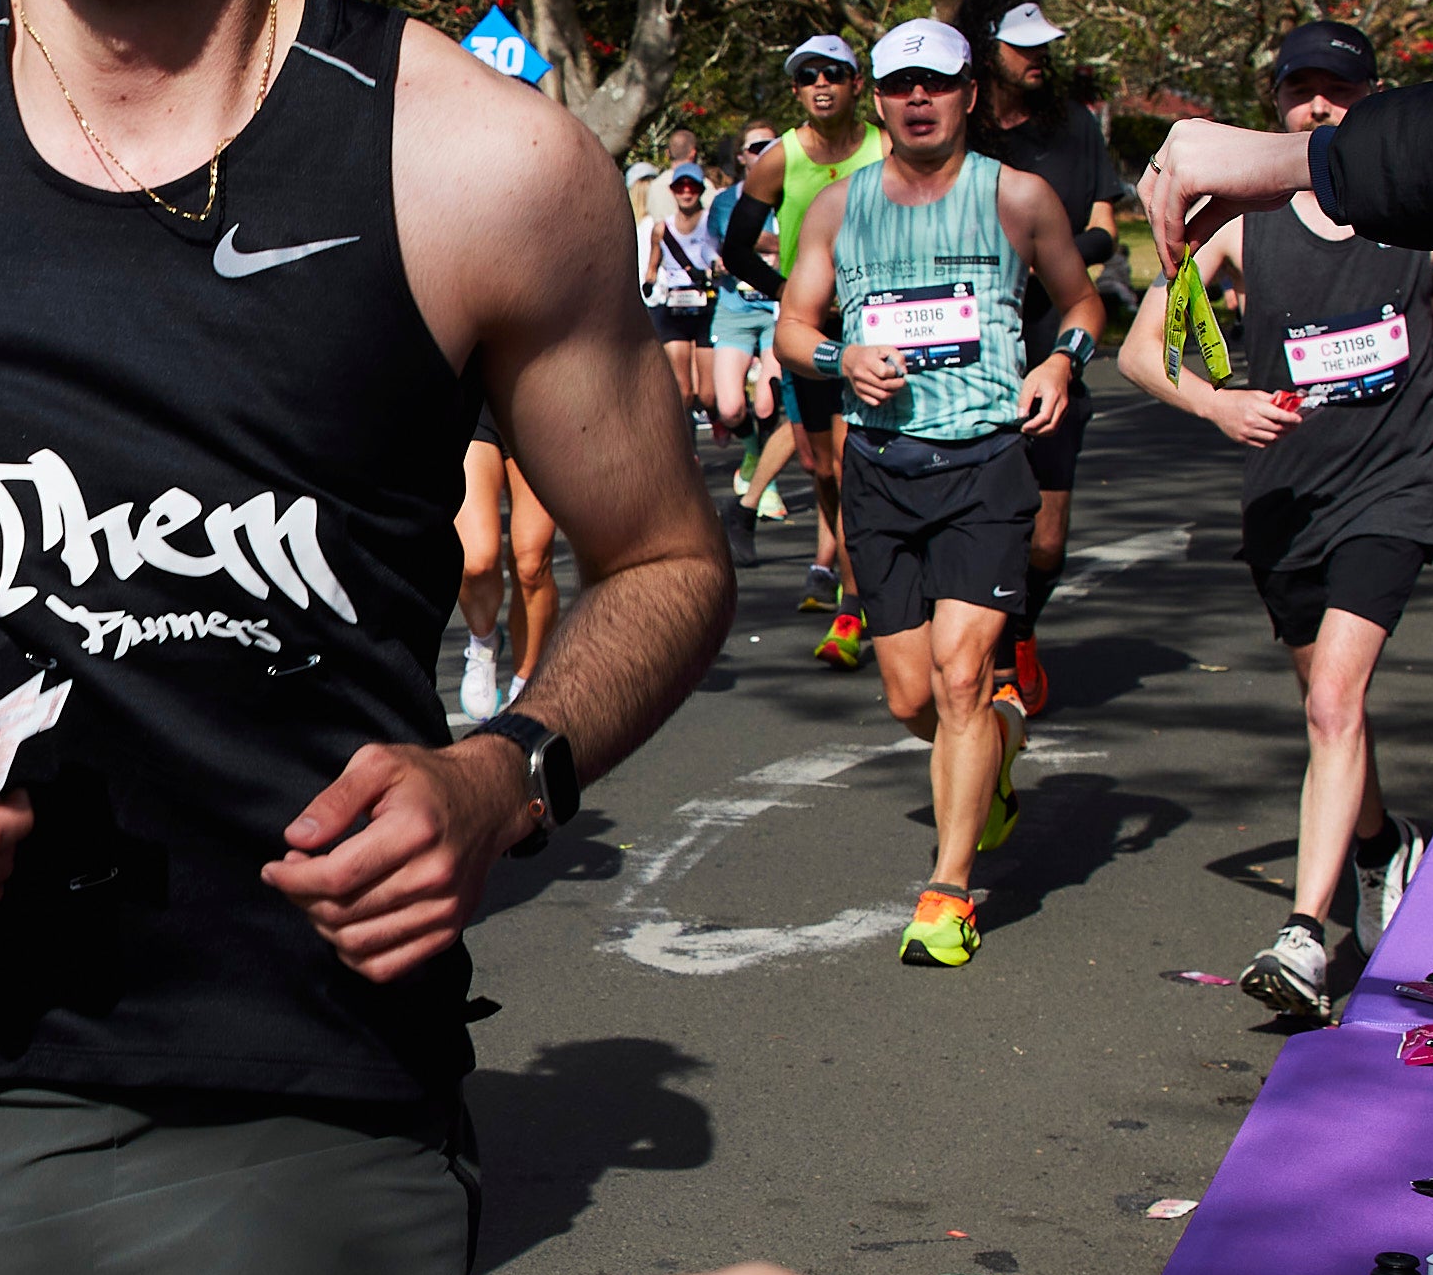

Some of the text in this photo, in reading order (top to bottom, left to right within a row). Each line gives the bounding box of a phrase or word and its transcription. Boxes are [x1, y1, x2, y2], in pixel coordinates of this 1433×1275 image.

[470, 36, 525, 76] 30
[894, 308, 944, 325] C31816
[905, 326, 936, 338] MARK
[1321, 334, 1375, 356] C31196
[1322, 351, 1381, 371] THE HAWK
